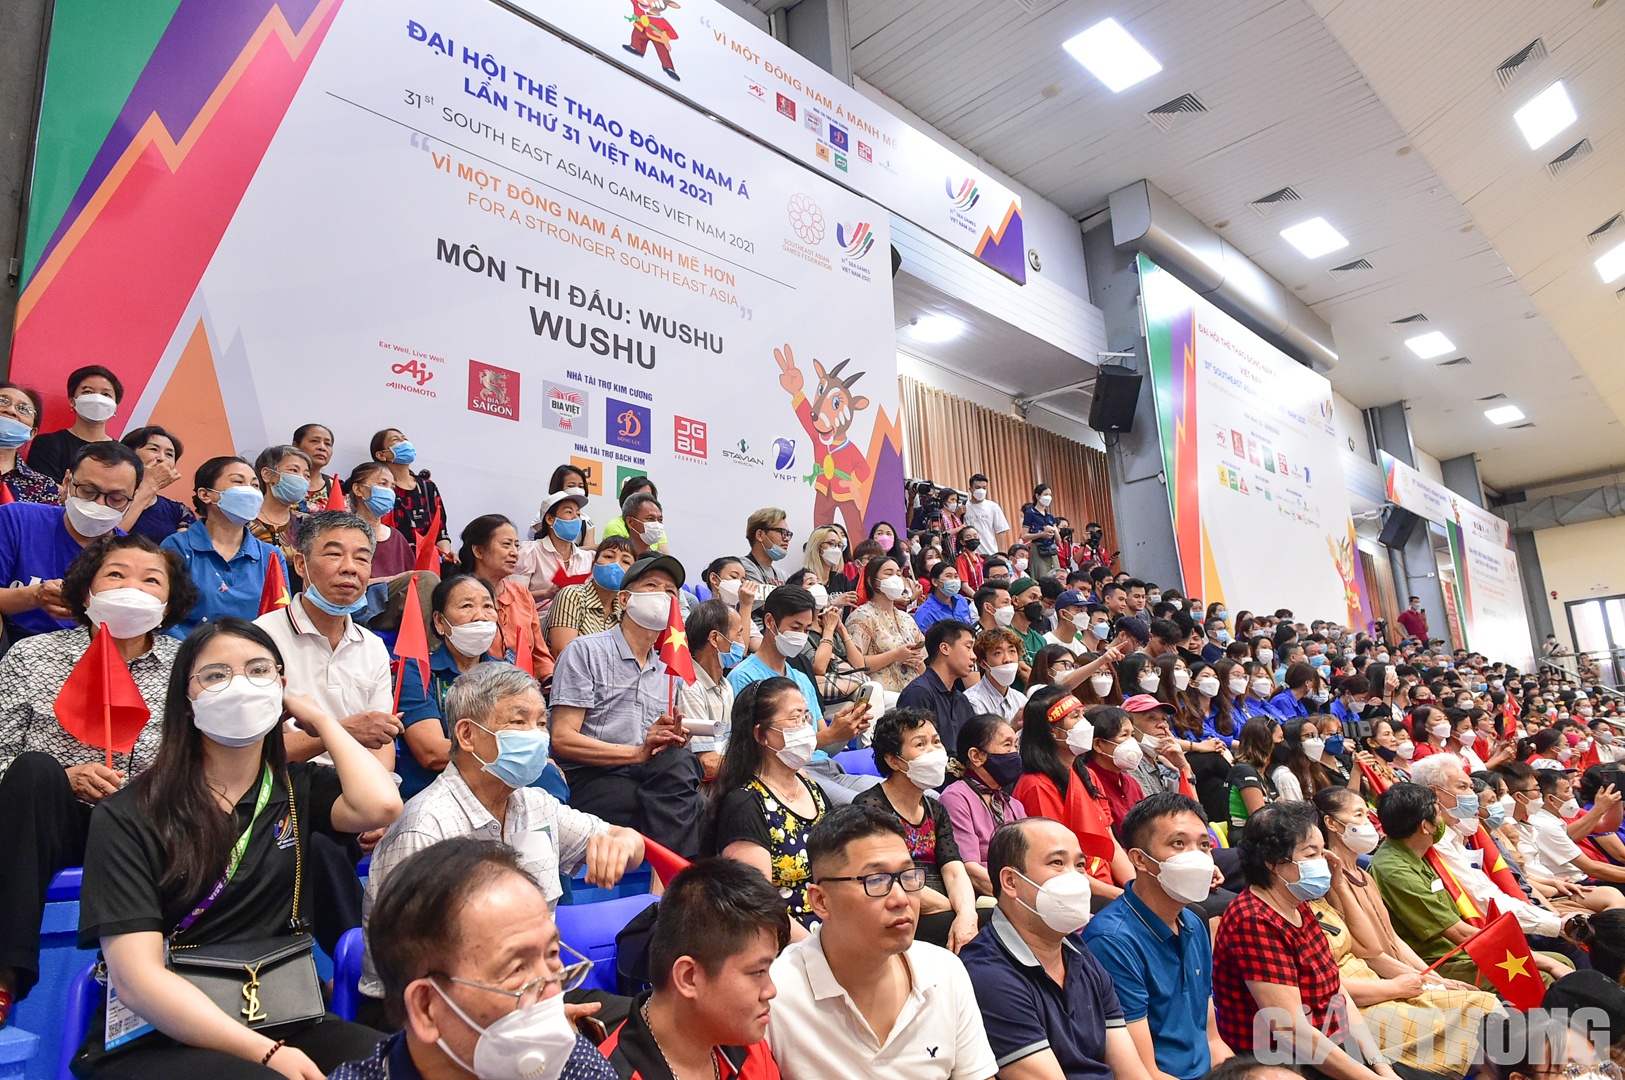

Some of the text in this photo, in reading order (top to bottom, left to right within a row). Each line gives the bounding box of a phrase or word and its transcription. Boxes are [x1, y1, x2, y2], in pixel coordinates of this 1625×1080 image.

[713, 28, 727, 46] VÌ
[731, 40, 761, 65] MỘT
[764, 60, 802, 92] ĐÔNG
[806, 86, 833, 111] NAM
[836, 103, 844, 118] Á
[847, 112, 880, 139] MẠNH
[406, 19, 750, 200] ĐẠI HỘI THỂ THAO ĐÔNG NAM Á
[464, 77, 713, 206] LẦN THỨ 31 VIỆT NAM 2021
[442, 107, 505, 145] SOUTH
[511, 136, 552, 165] EAST
[556, 158, 604, 189] ASIAN
[608, 181, 660, 213] GAMES
[663, 204, 693, 228] VIET
[696, 218, 726, 242] NAM
[729, 233, 755, 254] 2021
[457, 162, 501, 192] MỘT
[507, 183, 562, 217] ĐÔNG
[567, 207, 606, 236] NAM
[611, 224, 622, 243] Á
[627, 232, 673, 263] MẠNH
[678, 253, 699, 273] MẼ
[703, 263, 735, 287] HƠN
[468, 191, 739, 308] FOR A STRONGER SOUTH EAST ASIA
[782, 244, 832, 271] GAMES FEDERATION
[783, 238, 830, 263] SOUTHEAST ASIAN
[436, 237, 724, 355] MÔN THI ĐẤU: WUSHU
[379, 340, 391, 349] Eat
[412, 350, 427, 359] Live
[528, 305, 656, 370] WUSHU
[566, 370, 653, 401] NHÀ TÀI TRỢ KIM CƯƠNG
[472, 399, 513, 416] SAIGON
[551, 400, 564, 411] BIA
[565, 403, 580, 415] VIỆT
[574, 443, 645, 465] NHÀ TÀI TRỢ BẠCH KIM
[677, 435, 705, 455] BL
[722, 450, 764, 465] STAVIAN
[773, 472, 797, 482] VNPT
[208, 881, 223, 900] ASIA
